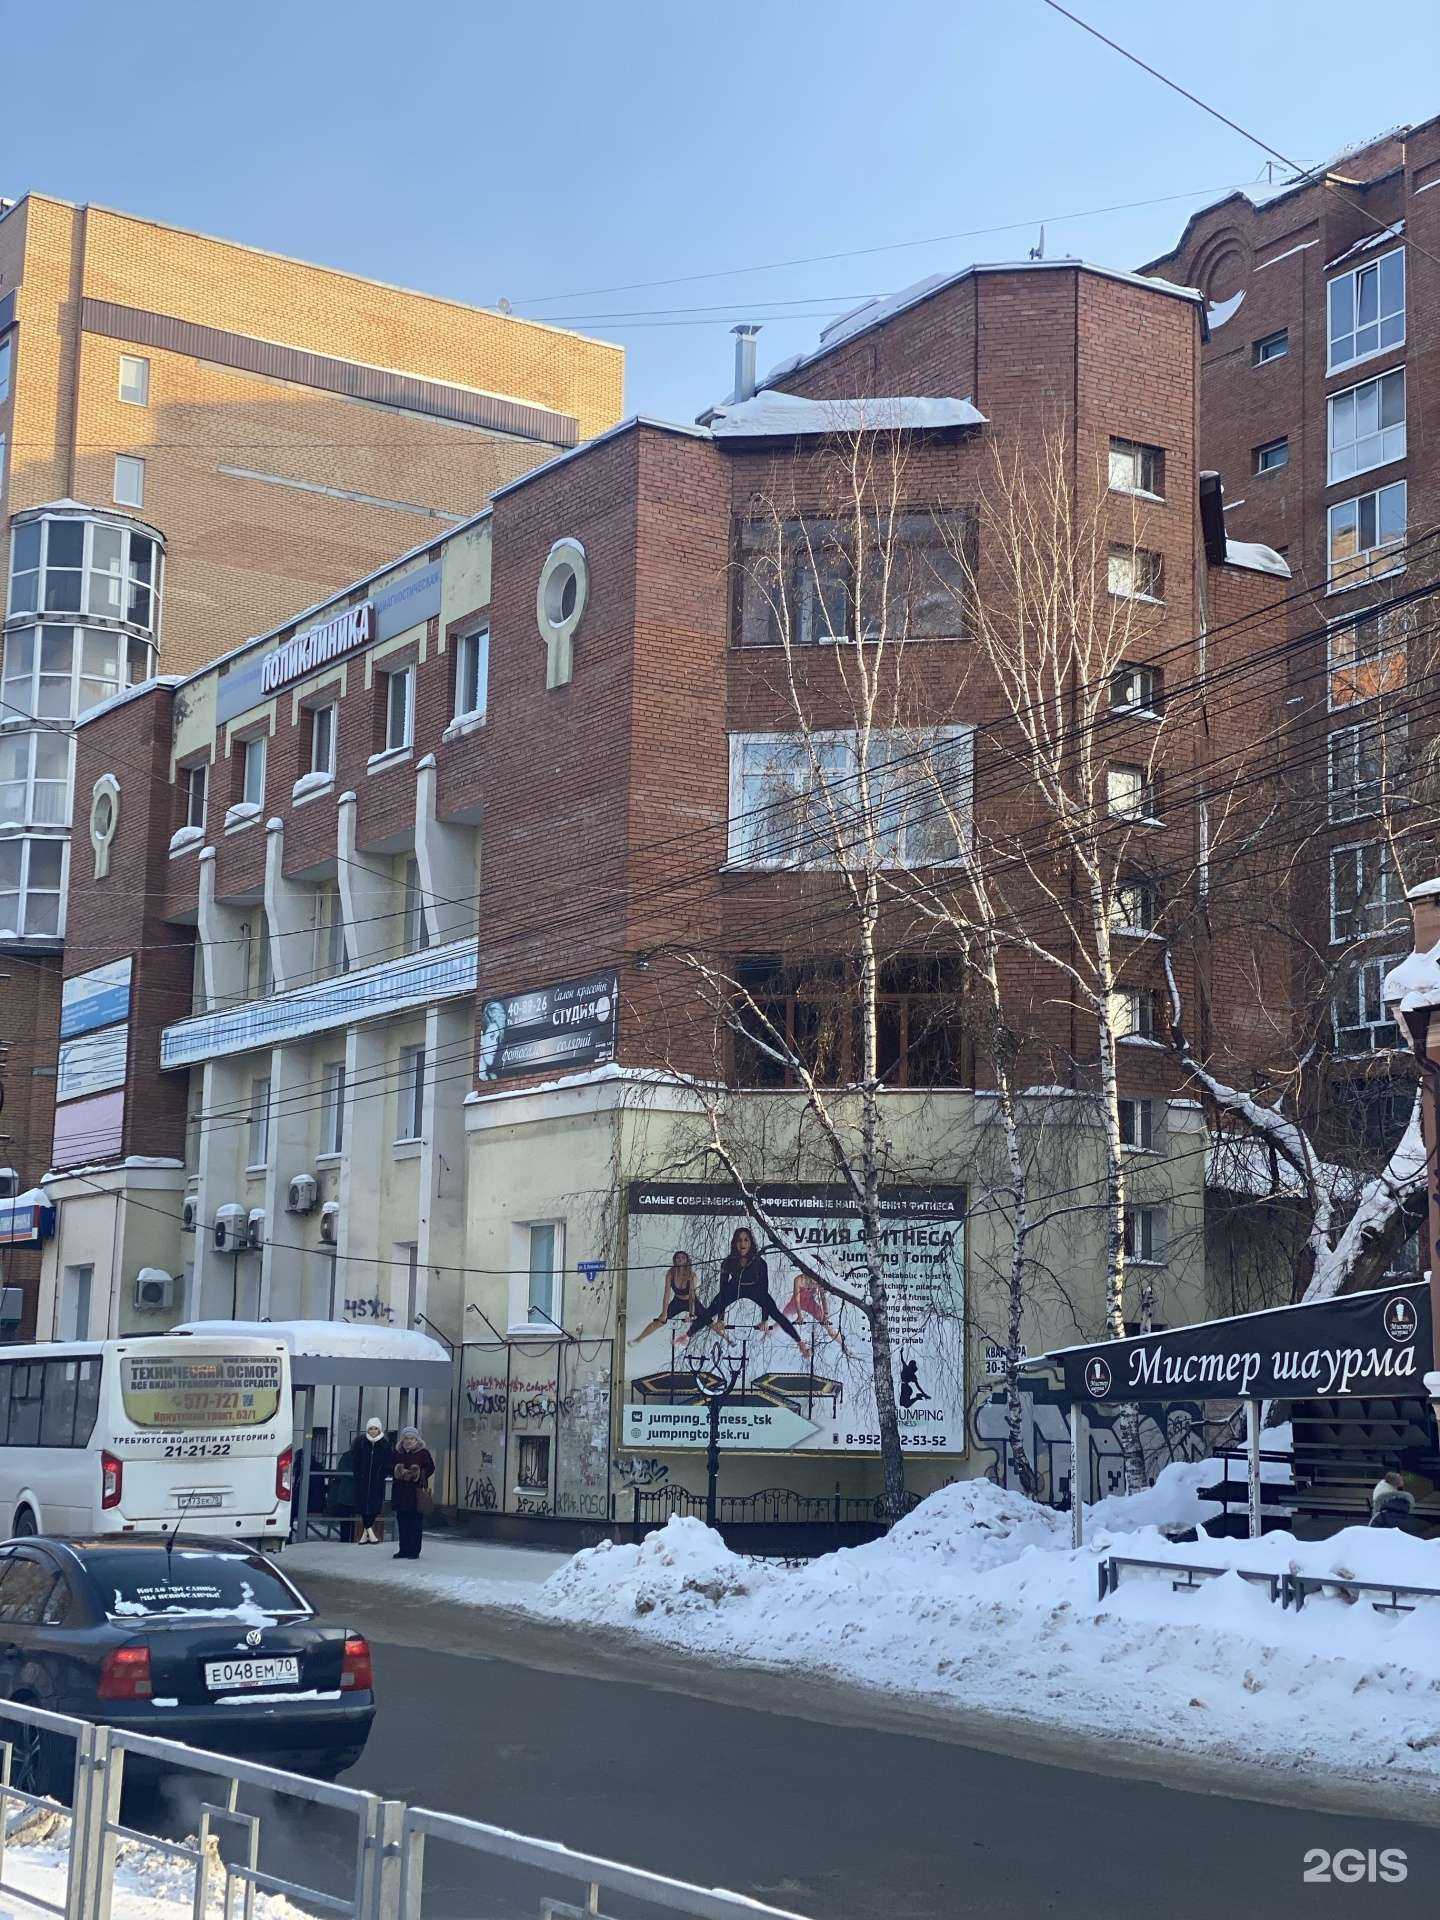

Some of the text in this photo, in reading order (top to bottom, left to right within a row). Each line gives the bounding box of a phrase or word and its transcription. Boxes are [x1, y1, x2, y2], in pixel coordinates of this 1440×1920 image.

[260, 602, 370, 694] ПОЛИКЛИНИКА
[554, 981, 608, 1002] Салон красоты
[552, 1002, 596, 1025] СТУДИЯ
[638, 1195, 675, 1205] САМЫЕ
[676, 1196, 745, 1207] СОВРЕМЕННЫ
[909, 1202, 955, 1211] ФИТНЕСА
[780, 1227, 850, 1245] ТУДИЯ
[226, 1365, 278, 1378] ОСМОТР
[1128, 1345, 1417, 1395] Мистер шаурма
[130, 1381, 147, 1390] ВСЕ
[148, 1380, 176, 1390] ВИДЫ
[243, 1379, 279, 1389] СРЕДСТВ
[184, 1392, 240, 1409] 577-727
[647, 1412, 772, 1427] jumping_fness_tsk
[113, 1433, 276, 1445] ТРЕБУЮТСЯ ВОДИТЕЛИ КАТЕГОРИИ D
[646, 1429, 750, 1441] jumpingtosk.ru
[164, 1444, 231, 1458] 21-21-22
[212, 1660, 292, 1682] Е048ЕМ 70
